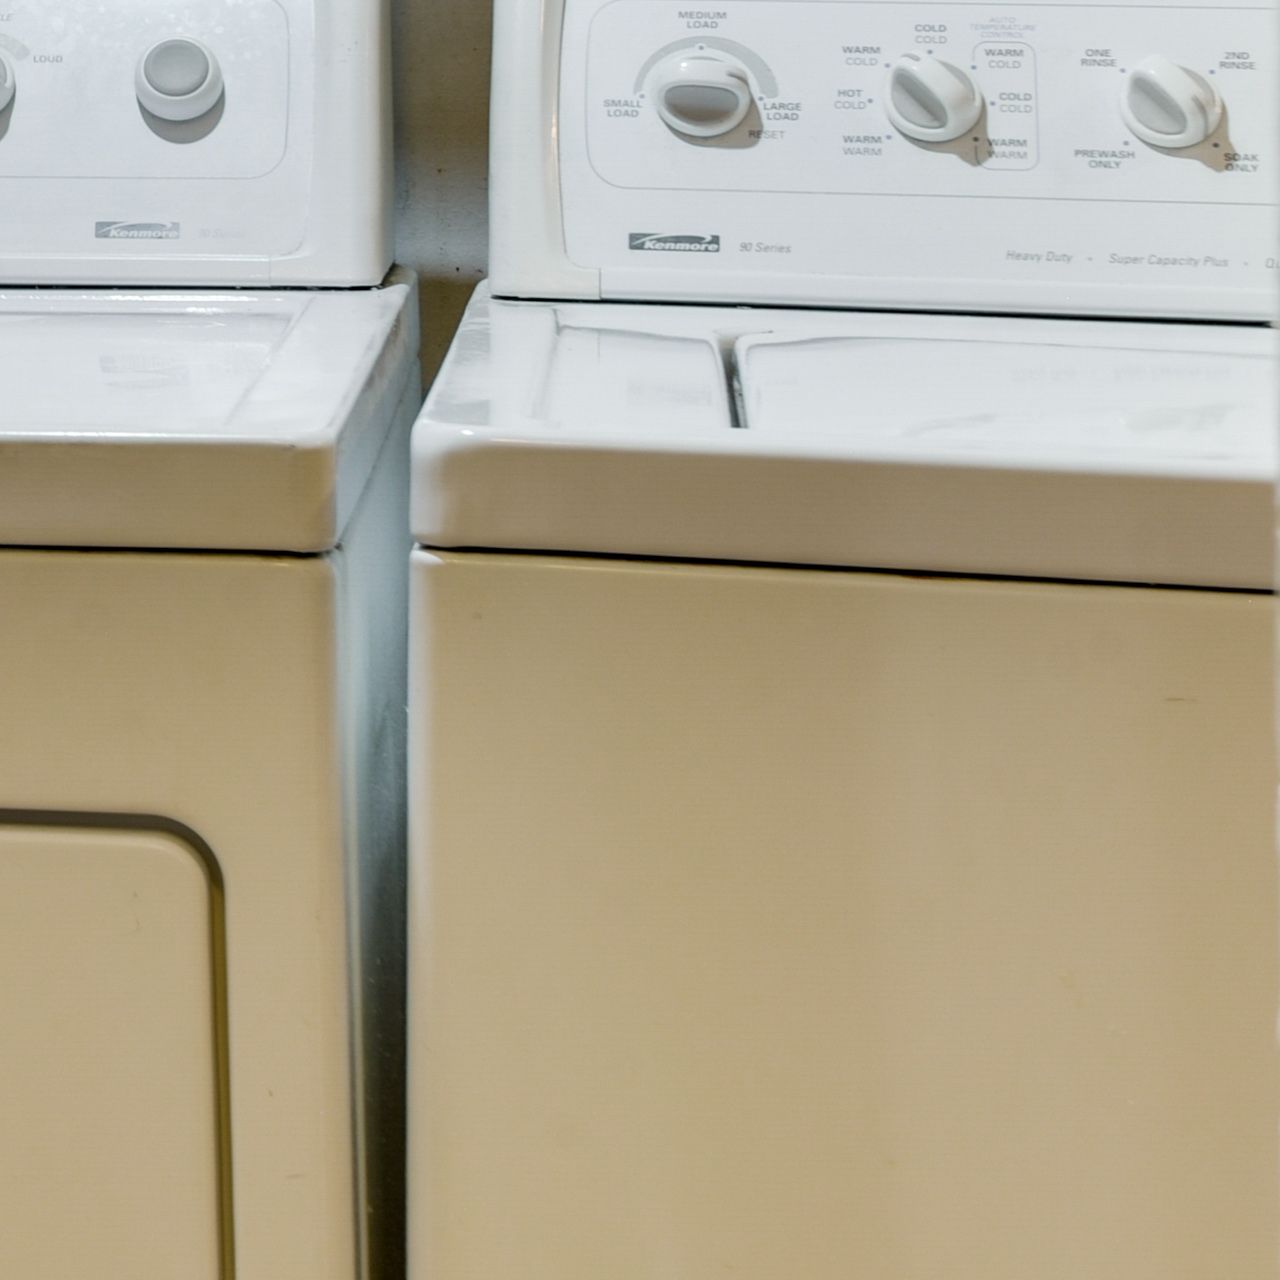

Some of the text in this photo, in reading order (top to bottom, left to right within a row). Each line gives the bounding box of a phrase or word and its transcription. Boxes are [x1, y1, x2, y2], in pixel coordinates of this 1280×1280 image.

[678, 11, 727, 19] MEDIUM
[686, 21, 719, 29] LOAD
[914, 24, 947, 33] COLD
[914, 35, 948, 44] COLD
[842, 46, 881, 54] WARM
[984, 49, 1024, 57] WARM
[1085, 49, 1112, 57] ONE
[33, 55, 63, 64] LOUD
[1224, 52, 1250, 60] 2ND
[845, 57, 878, 66] COLD
[988, 60, 1021, 69] COLD
[1081, 58, 1117, 67] RINSE
[1219, 61, 1256, 70] RINSE
[837, 89, 863, 98] HOT
[999, 93, 1032, 101] COLD
[603, 99, 643, 108] SMALL
[763, 102, 802, 111] LARGE
[834, 101, 866, 110] COLD
[607, 109, 639, 118] LOAD
[999, 105, 1033, 113] COLD
[766, 112, 799, 121] LOAD
[748, 130, 785, 139] RESET
[843, 135, 882, 144] WARM
[988, 139, 1028, 147] WARM
[843, 147, 882, 156] WARM
[987, 151, 1028, 160] WARM
[1074, 149, 1135, 158] PREWASH
[1224, 153, 1259, 162] SOAK
[1088, 160, 1122, 169] ONLY
[1224, 163, 1259, 172] ONLY
[109, 228, 178, 239] Kenmore
[644, 240, 792, 253] Kenmore 90 Series
[1006, 250, 1073, 263] Heavy Duty
[1109, 253, 1229, 268] Super Capacity Plus
